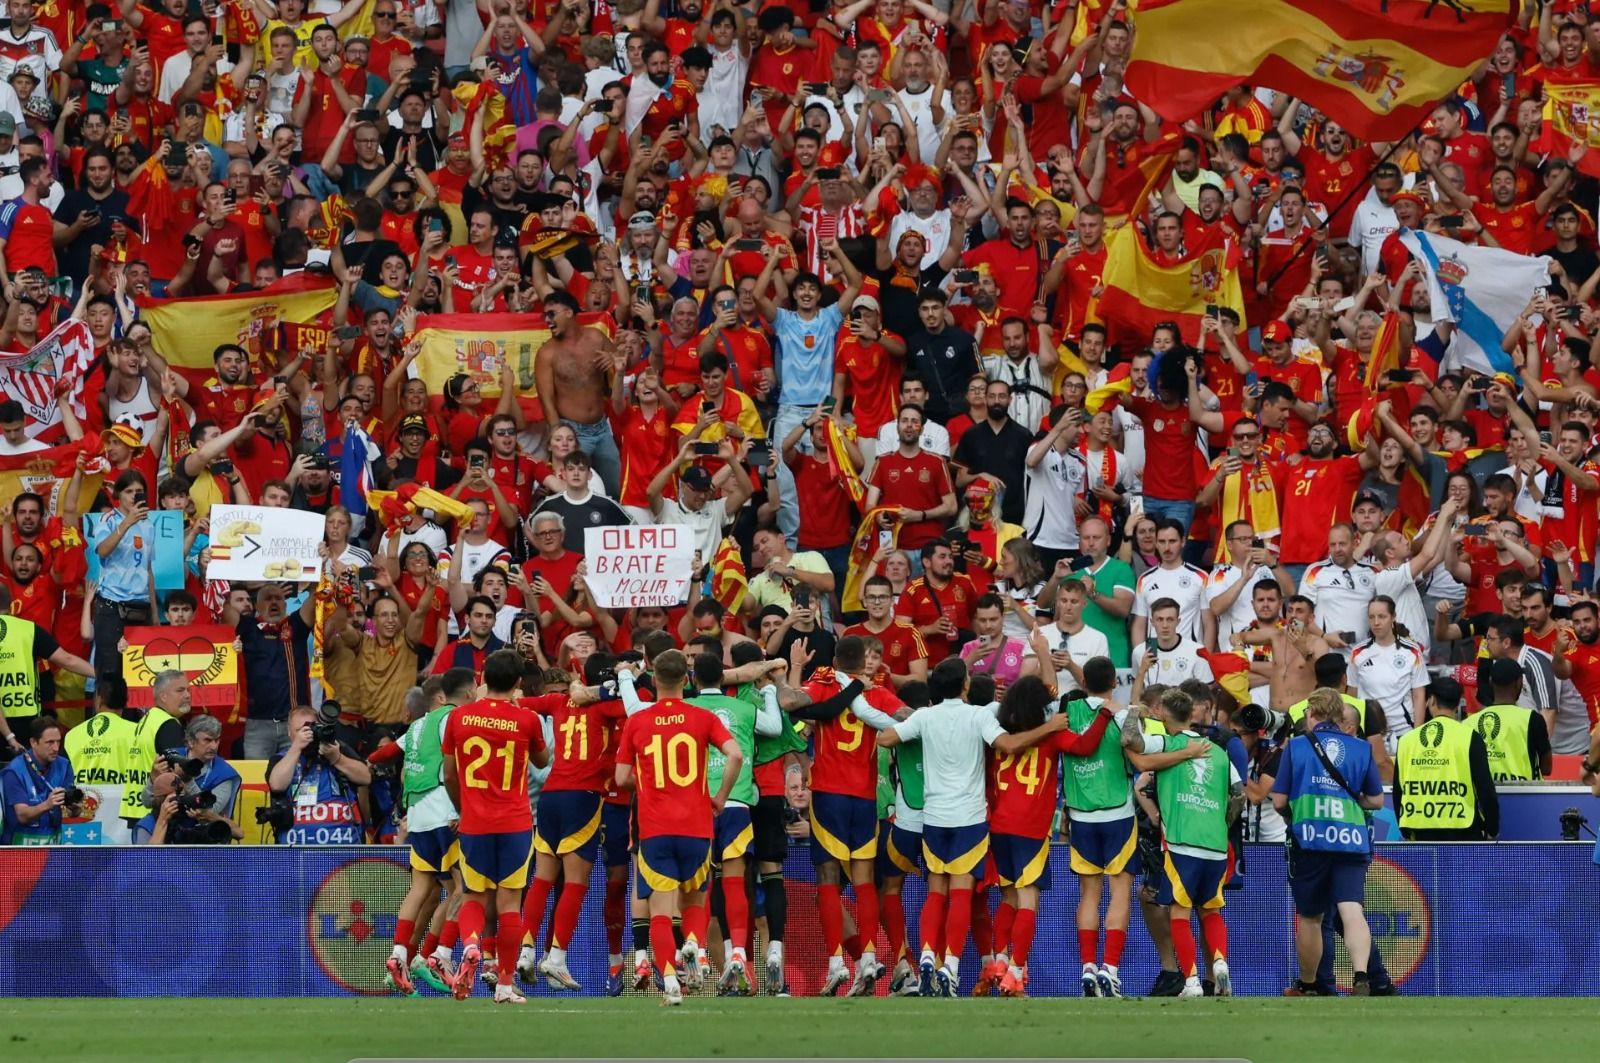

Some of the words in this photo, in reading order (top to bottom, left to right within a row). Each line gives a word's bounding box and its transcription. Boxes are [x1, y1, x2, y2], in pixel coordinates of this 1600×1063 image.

[322, 94, 330, 111] 5
[1326, 179, 1341, 193] 22
[1217, 379, 1234, 396] 21
[1295, 479, 1312, 496] 21
[270, 537, 313, 548] NORMALE
[603, 527, 677, 550] OLMO
[133, 551, 142, 568] 9
[596, 555, 667, 574] BRATE
[611, 596, 625, 607] LA
[630, 596, 677, 607] CAMISA
[191, 645, 228, 687] WILLIAMS
[462, 715, 520, 733] OYARZABAL
[655, 713, 685, 726] OLMO
[560, 714, 588, 761] 11
[837, 707, 865, 752] 9
[463, 735, 516, 791] 21
[644, 732, 698, 789] 10
[1411, 758, 1450, 766] EURO2024
[996, 747, 1040, 795] 24
[1311, 775, 1349, 787] EURO2
[1402, 780, 1468, 798] TEWARD
[1176, 792, 1219, 810] EURO2024
[1314, 797, 1345, 819] HB
[293, 802, 352, 821] HOTO
[286, 827, 353, 845] 01-044
[318, 899, 398, 939] LID
